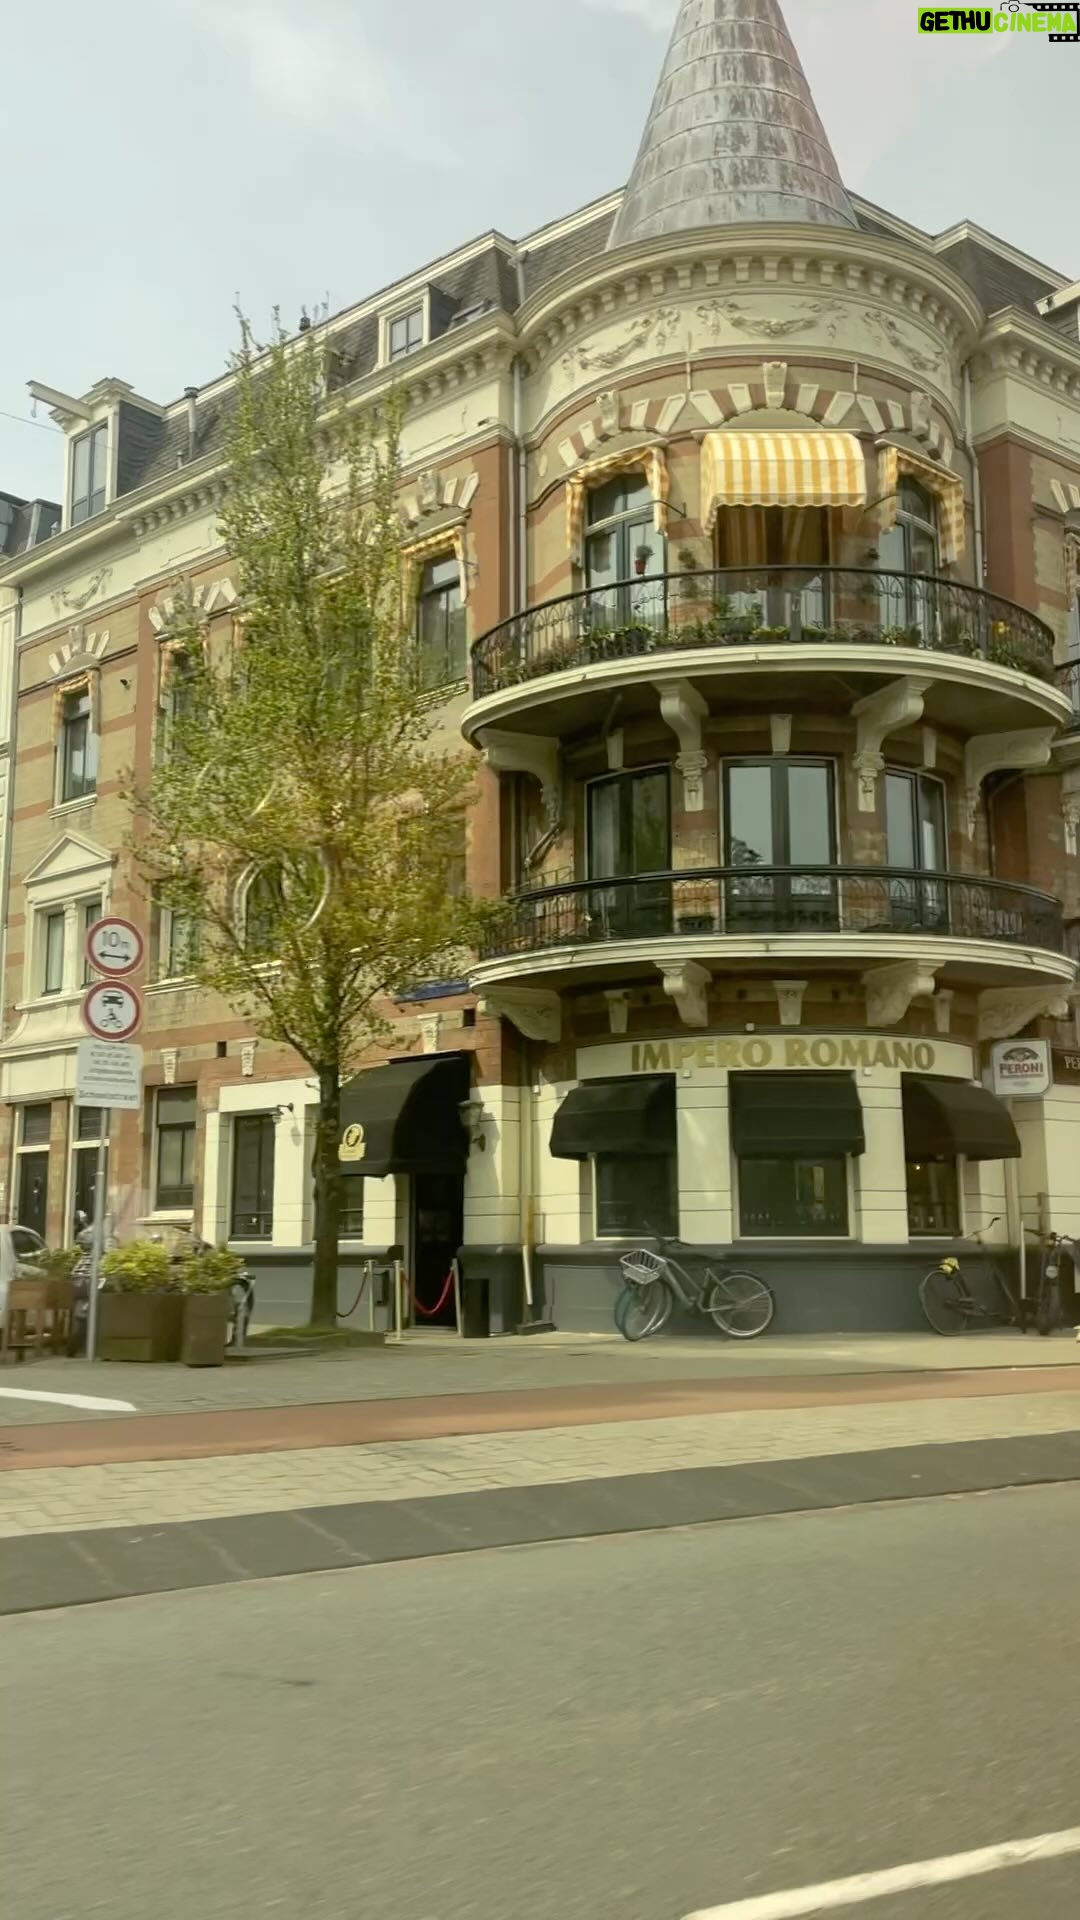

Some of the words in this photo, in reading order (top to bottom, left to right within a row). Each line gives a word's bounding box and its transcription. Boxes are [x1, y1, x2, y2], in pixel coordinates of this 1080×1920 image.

[631, 1039, 773, 1072] IMPERO
[784, 1038, 936, 1071] ROMANO
[999, 1063, 1044, 1074] PERONI
